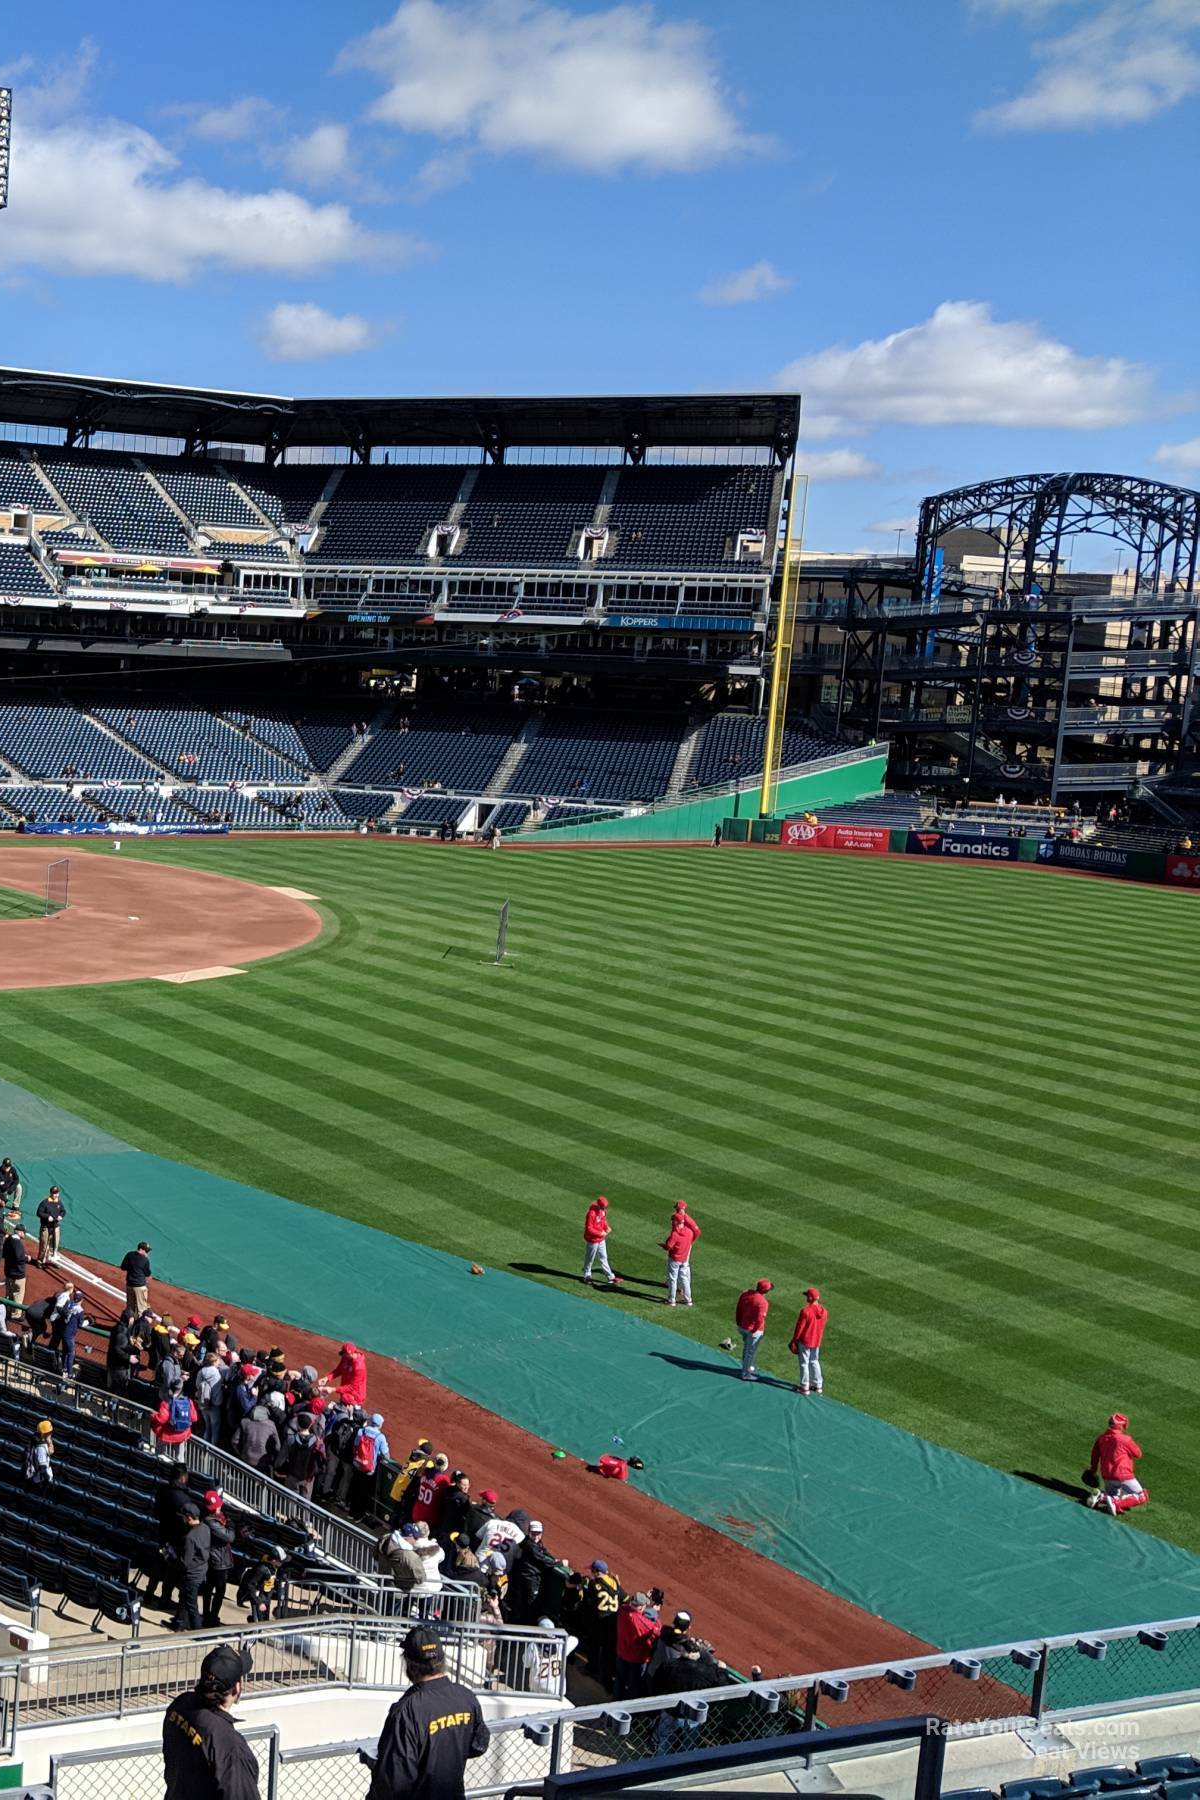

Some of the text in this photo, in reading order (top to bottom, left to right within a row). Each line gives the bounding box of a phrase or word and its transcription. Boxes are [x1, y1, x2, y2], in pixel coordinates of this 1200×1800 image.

[348, 615, 377, 623] OPENING
[620, 616, 658, 626] KOPPERS
[791, 825, 814, 839] AAA
[837, 828, 883, 837] Auto Insurance
[844, 840, 874, 849] AAA.com
[941, 838, 1010, 857] Fanatics
[1059, 845, 1090, 860] BORDAS
[1093, 850, 1127, 864] BORDAS
[418, 1485, 433, 1505] 50
[489, 1532, 513, 1553] 25
[538, 1660, 561, 1679] 28
[168, 1710, 203, 1746] STAFF
[429, 1711, 472, 1735] STAFF
